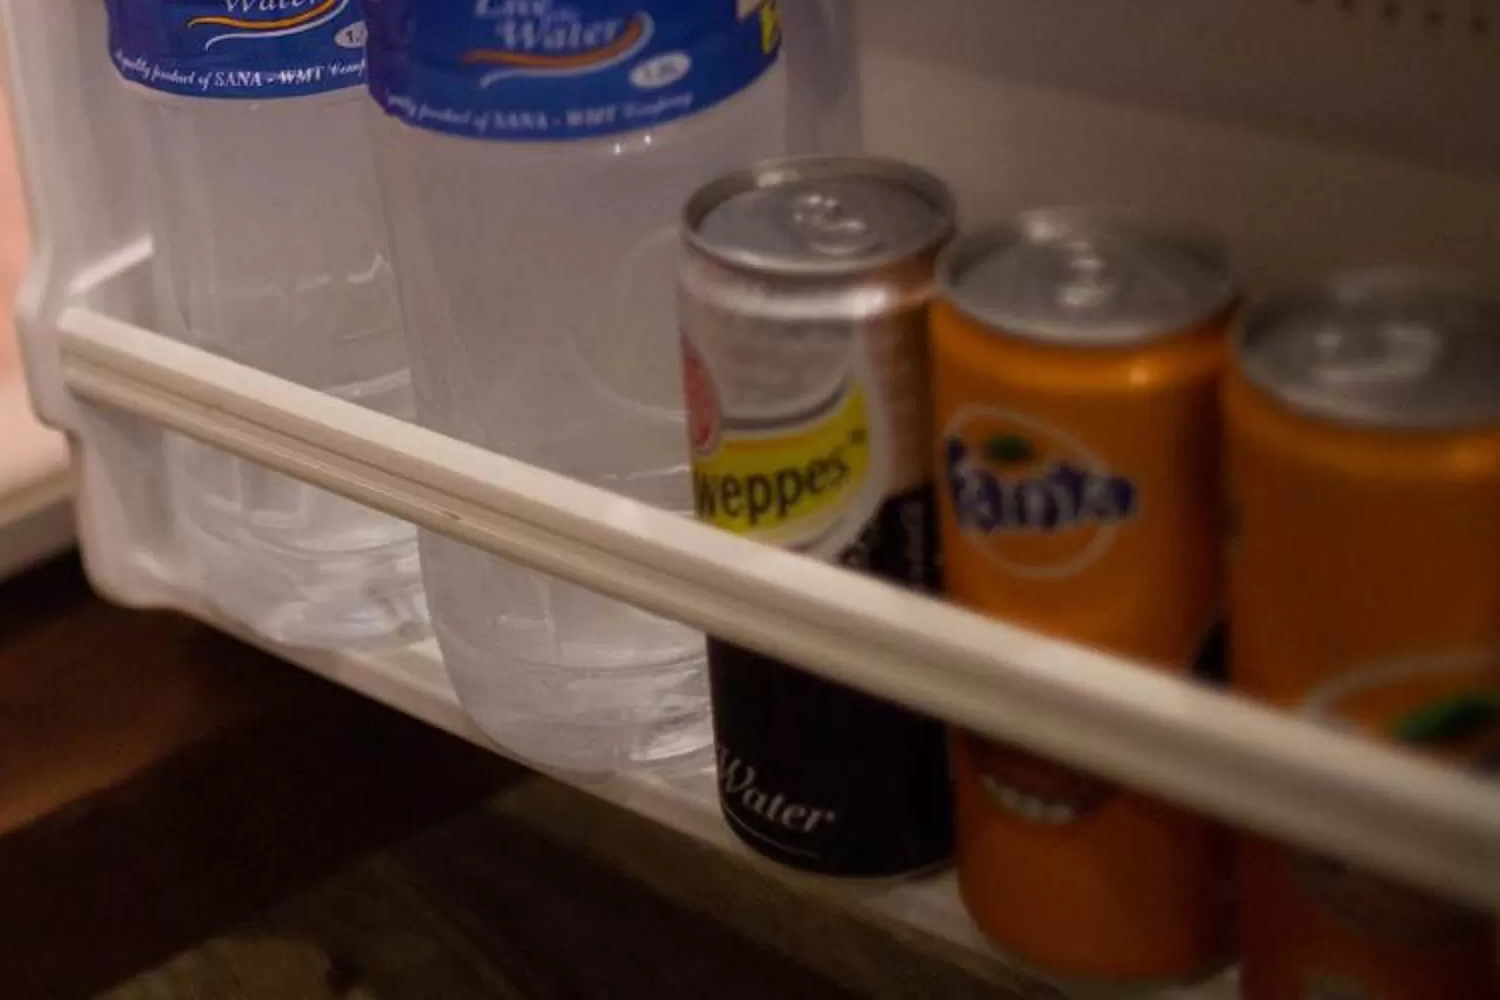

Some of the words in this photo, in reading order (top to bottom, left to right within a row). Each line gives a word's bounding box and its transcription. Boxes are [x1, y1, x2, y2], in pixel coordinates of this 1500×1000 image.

[214, 71, 263, 87] SANA
[694, 450, 851, 526] weppes
[716, 743, 837, 833] Water
